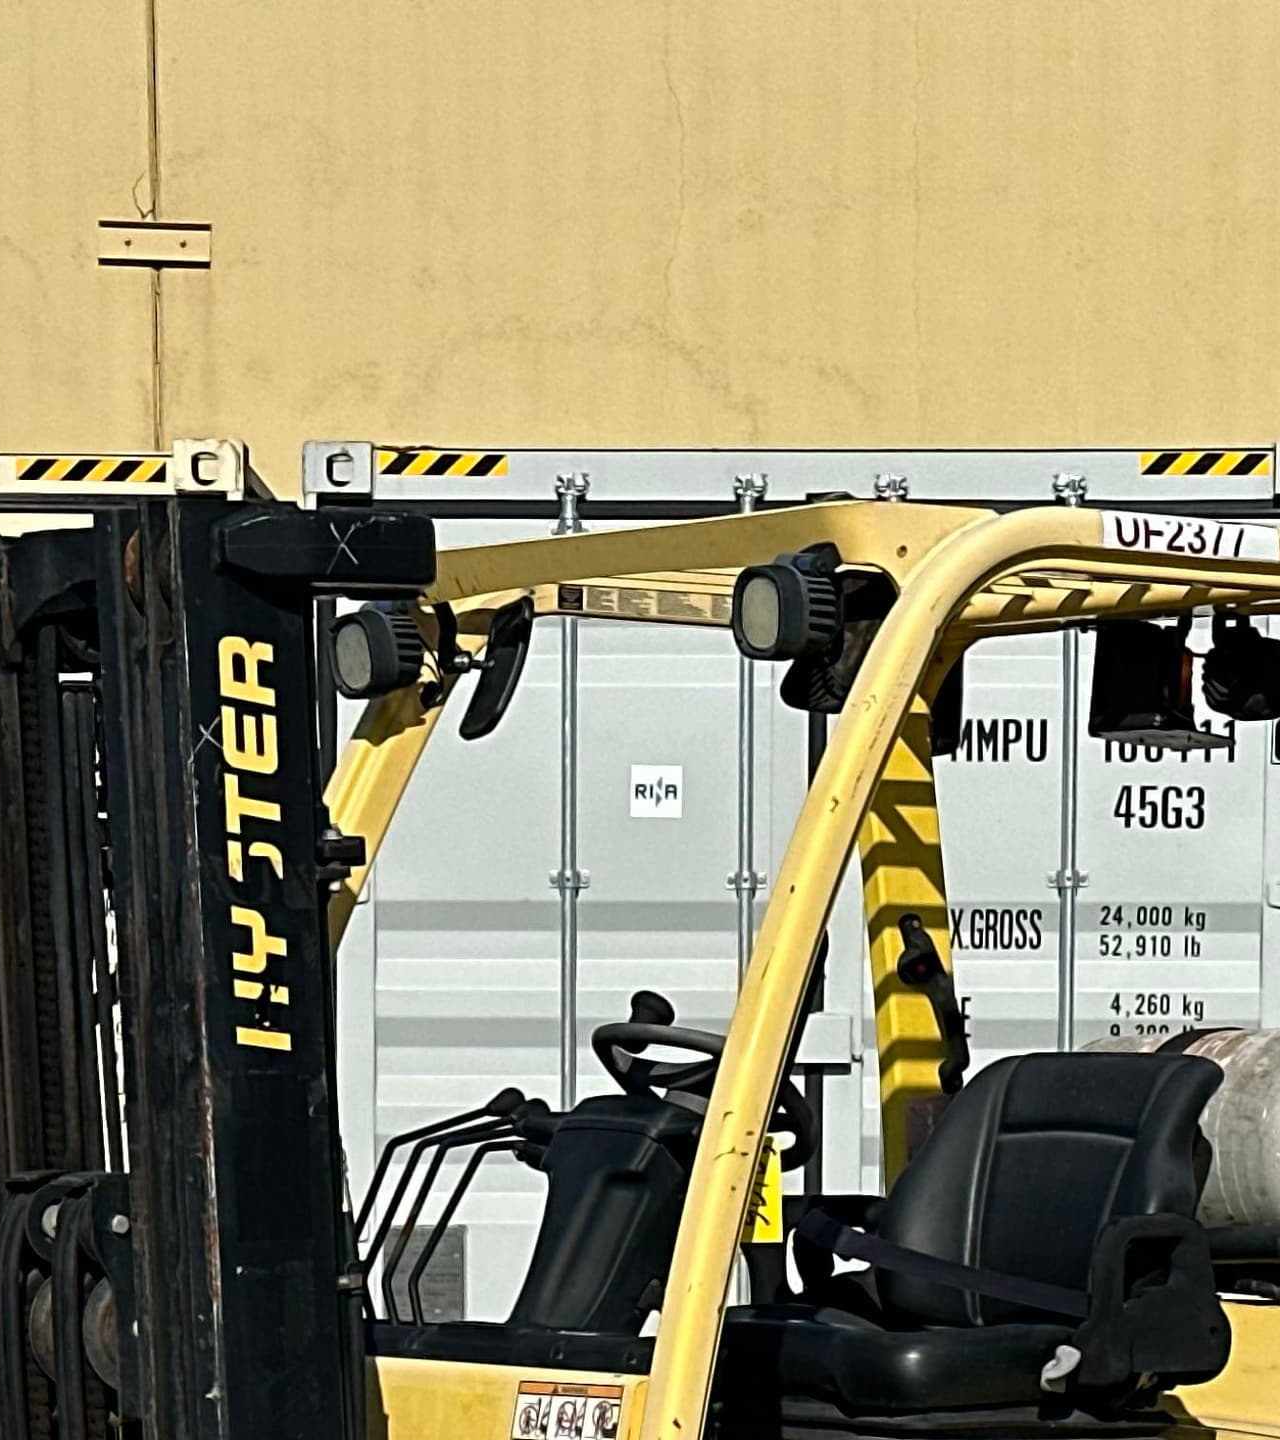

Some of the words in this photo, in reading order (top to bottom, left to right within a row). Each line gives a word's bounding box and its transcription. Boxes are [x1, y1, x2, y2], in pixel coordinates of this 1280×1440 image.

[1113, 784, 1206, 830] 45G3
[1099, 904, 1172, 930] 24,000
[1183, 905, 1207, 932] kg
[1099, 934, 1172, 960] 52,910
[1183, 934, 1202, 958] lb
[1110, 993, 1171, 1018] 4,260
[1182, 995, 1205, 1021] kg
